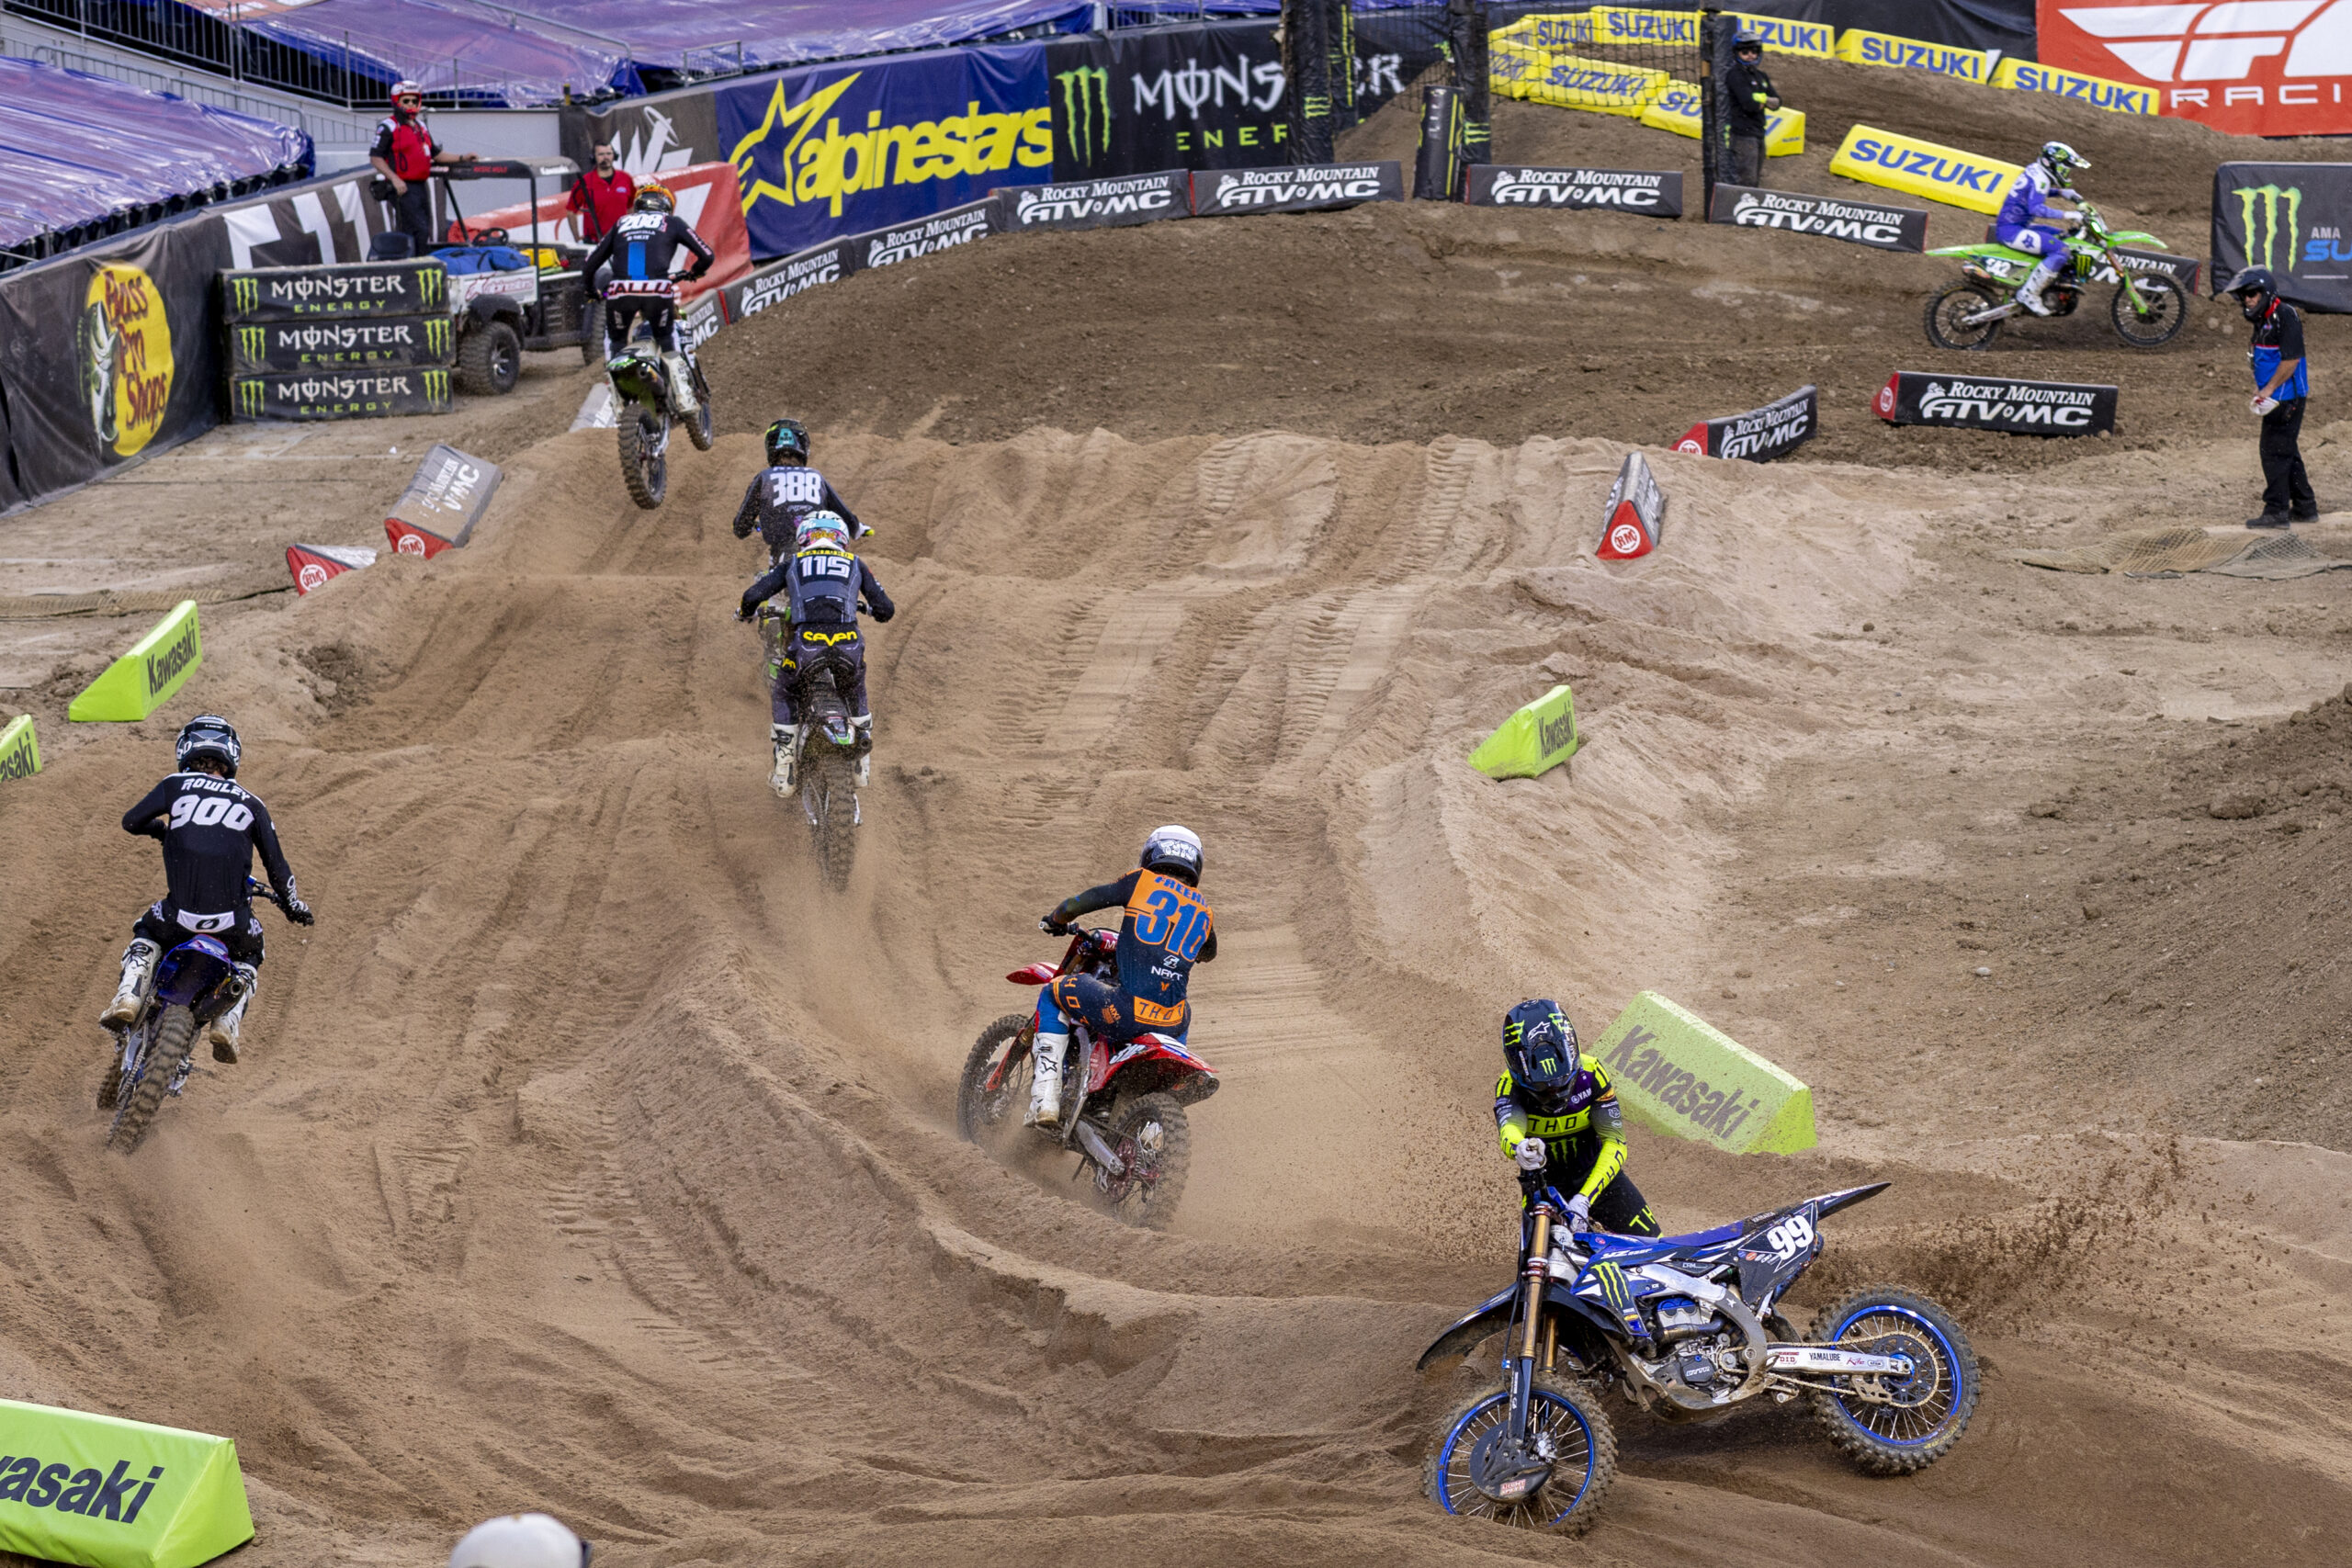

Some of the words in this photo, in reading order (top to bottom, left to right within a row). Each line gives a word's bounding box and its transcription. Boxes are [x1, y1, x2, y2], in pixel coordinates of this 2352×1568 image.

[1538, 19, 1593, 46] SUZUKI
[1607, 12, 1695, 42] SUZUKI
[1736, 17, 1828, 53] UZUKI
[1862, 36, 1979, 79] SUZUKI
[1545, 65, 1647, 97] SUZUKI
[2015, 66, 2150, 115] SUZUKI
[1177, 124, 1287, 152] ENER
[795, 101, 1054, 218] alpinestars
[1849, 140, 2004, 194] SUZUKI
[1041, 186, 1086, 201] ROCKY
[1090, 176, 1168, 193] MOUNTAIN
[1242, 171, 1291, 184] ROCKY
[1295, 167, 1378, 182] MOUNTAIN
[1519, 170, 1570, 184] ROCKY
[1572, 170, 1661, 186] MOUNTAIN
[618, 212, 664, 234] 208
[1761, 194, 1814, 212] ROCKY
[1816, 203, 1904, 225] MOUNTAIN
[887, 229, 923, 248] ROCKY
[924, 209, 986, 238] MOUNTAIN
[2311, 227, 2341, 239] AMA
[755, 268, 786, 294] ROCKY
[787, 249, 838, 279] MOUNTAIN
[2098, 253, 2177, 275] OUNTAIN
[104, 270, 149, 324] Bass
[271, 275, 406, 301] MONSTER
[294, 300, 386, 313] ENERGY
[118, 322, 147, 374] Pro
[278, 325, 413, 350] MONSTER
[301, 350, 393, 363] ENERGY
[126, 371, 167, 433] Shops
[277, 377, 413, 402] MONSTER
[1949, 382, 2004, 399] ROCKY
[2006, 386, 2096, 406] MOUNTAIN
[300, 401, 392, 414] ENERGY
[1736, 418, 1765, 435] ROCKY
[1765, 399, 1809, 428] MOUNTAIN
[770, 471, 822, 507] 388
[800, 556, 851, 579] 115
[147, 617, 197, 698] Kawasaki
[1538, 700, 1575, 760] Kawasaki
[181, 778, 251, 801] ROWLEY
[170, 794, 255, 831] 900
[1135, 889, 1211, 962] 316
[1603, 1024, 1762, 1140] Kawasaki
[1527, 1107, 1590, 1133] THO
[1767, 1214, 1815, 1260] 99
[1809, 1352, 1841, 1362] YAMALUBE
